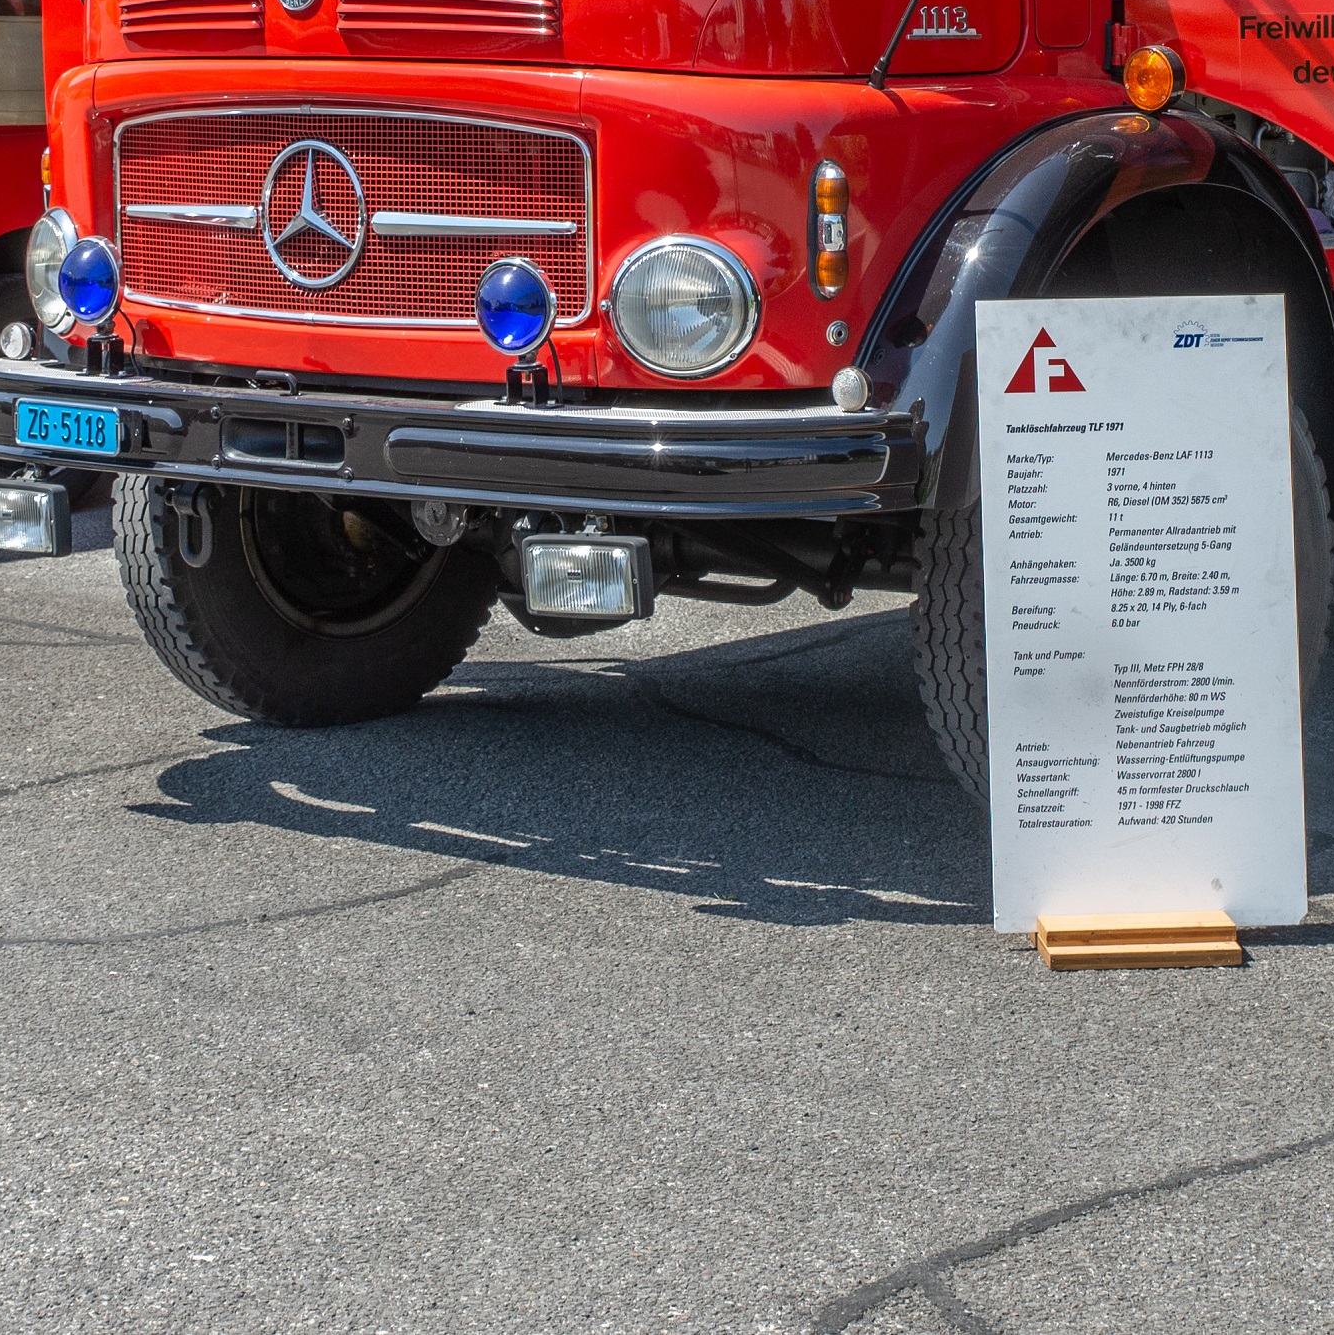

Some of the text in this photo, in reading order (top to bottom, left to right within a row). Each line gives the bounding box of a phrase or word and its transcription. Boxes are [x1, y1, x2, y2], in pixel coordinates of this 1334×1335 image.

[920, 7, 969, 34] 1113
[1173, 333, 1204, 348] ZDT
[1005, 422, 1124, 434] Tanklöschfahrzeug TLF 1971
[1006, 453, 1055, 465] Marke/Typ:
[1105, 449, 1214, 461] Mercedes-Benz LAF 1113
[1007, 469, 1044, 480] Baujahr:
[1107, 467, 1125, 477] 1971
[1007, 483, 1048, 494] Platzzahl:
[1106, 481, 1177, 492] 3 vorne, 4 hinten
[1007, 499, 1037, 509] Motor:
[1107, 497, 1121, 507] R6,
[1122, 496, 1150, 506] Diesel
[1151, 495, 1171, 507] (OM
[1170, 495, 1189, 506] 352)
[1190, 495, 1211, 505] 5675
[1008, 513, 1078, 525] Gesamtgewicht:
[1109, 512, 1124, 522] 11 t
[1008, 529, 1043, 539] Antrieb:
[1108, 524, 1237, 537] Permanenter Allradantrieb mit
[1109, 539, 1232, 553] Geländeuntersetzung 5-Gang
[1009, 558, 1077, 571] Anhängehaken:
[1109, 556, 1157, 568] Ja. 3500 kg
[1010, 575, 1080, 586] Fahrzeugmasse:
[1109, 570, 1231, 584] Länge: 6.70 m, Breite: 2.40 m,
[1110, 585, 1240, 597] Höhe: 2.89 m, Radstand: 3.59 m
[1011, 604, 1057, 616] Bereifung:
[1110, 600, 1207, 613] 8.25 x 20, 14 Ply, 6-fach
[1011, 619, 1061, 630] Pneudruck:
[1111, 617, 1141, 628] 6.0 bar
[1013, 649, 1086, 661] Tank und Pumpe:
[1013, 666, 1046, 677] Pumpe:
[1113, 661, 1204, 675] Typ III, Metz FPH 28/8
[1113, 678, 1190, 688] Nennförderstrom:
[1190, 676, 1211, 686] 2800
[1114, 692, 1187, 704] Nennförderhöhe:
[1188, 692, 1199, 702] 80
[1210, 691, 1227, 701] WS
[1114, 707, 1225, 720] Zweistufige Kreiselpumpe
[1115, 721, 1247, 734] Tank- und Saugbetrieb möglich
[1015, 742, 1050, 752] Antrieb:
[1115, 737, 1215, 749] Nebenantrieb Fahrzeug
[1015, 756, 1101, 769] Ansaugvorrichtung:
[1116, 753, 1245, 765] Wasserring-Entlüftungspumpe
[1016, 772, 1071, 783] Wassertank:
[1117, 770, 1176, 780] Wasservorrat
[1176, 768, 1197, 778] 2800
[1016, 786, 1080, 799] Schnellangriff:
[1116, 782, 1250, 795] 45 m formfester Druckschlauch
[1017, 802, 1065, 813] Einsatzzeit:
[1118, 801, 1137, 810] 1971
[1145, 800, 1165, 810] 1998
[1165, 799, 1182, 809] FFZ
[1018, 817, 1093, 829] Totalrestauration:
[1117, 814, 1213, 826] Aufwand: 420 Stunden
